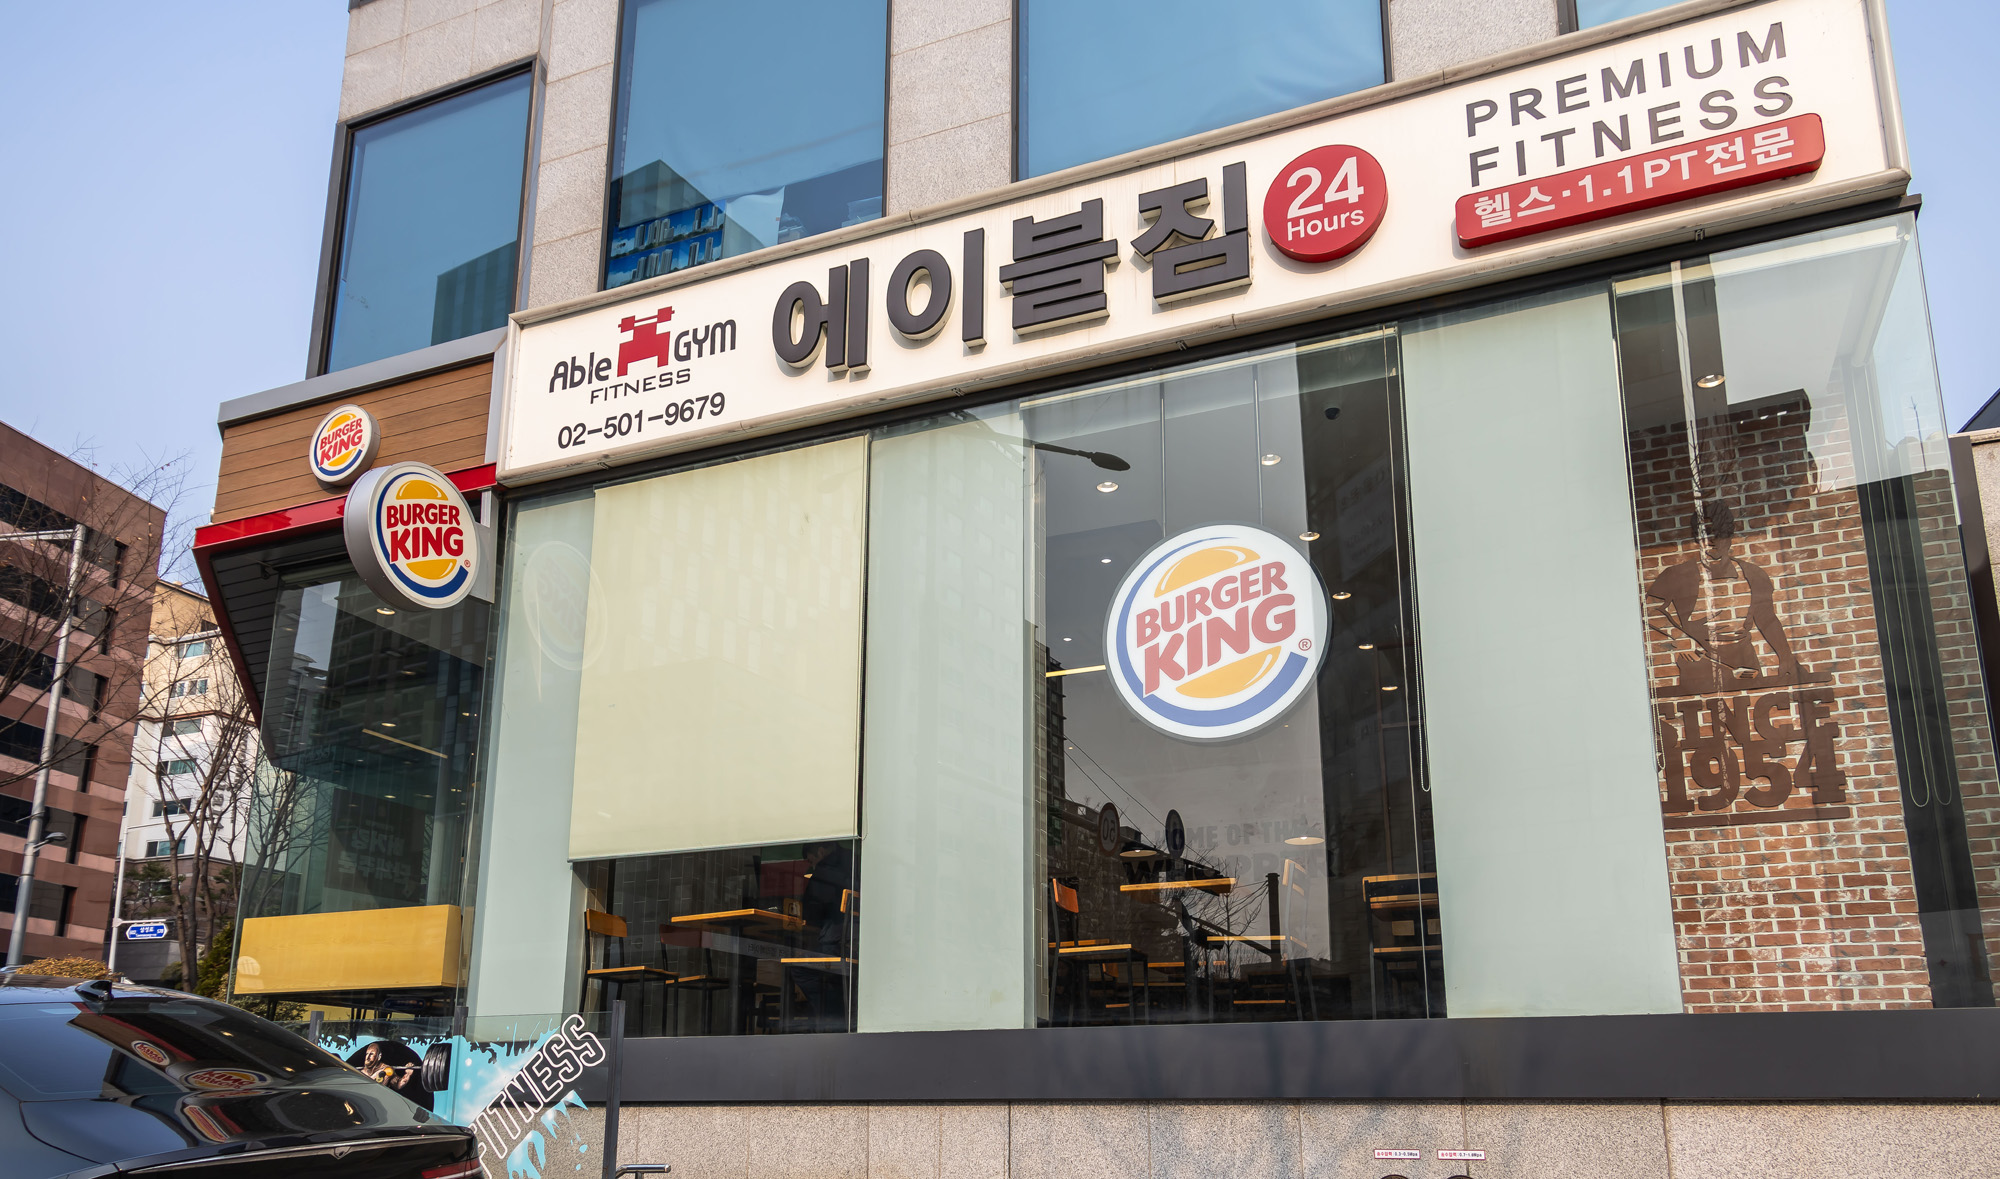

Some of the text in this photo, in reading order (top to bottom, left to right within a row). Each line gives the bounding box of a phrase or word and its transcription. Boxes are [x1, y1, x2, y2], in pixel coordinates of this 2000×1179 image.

[1465, 21, 1787, 138] PREMIUM
[1469, 76, 1794, 188] FITNESS
[1286, 156, 1365, 219] 24
[1287, 206, 1365, 241] Hours
[771, 161, 1252, 374] 에이블짐
[549, 318, 737, 393] Able GYM
[590, 368, 691, 405] FITNESS
[319, 429, 363, 467] KING
[320, 418, 363, 451] BURGER
[557, 392, 726, 450] 02-501-9679
[386, 503, 461, 529] BURGER
[389, 526, 464, 563] KING
[1136, 561, 1288, 649] BURGER
[1144, 593, 1296, 695] KING
[1653, 688, 1835, 749] SINCE
[1658, 722, 1847, 814] 1954
